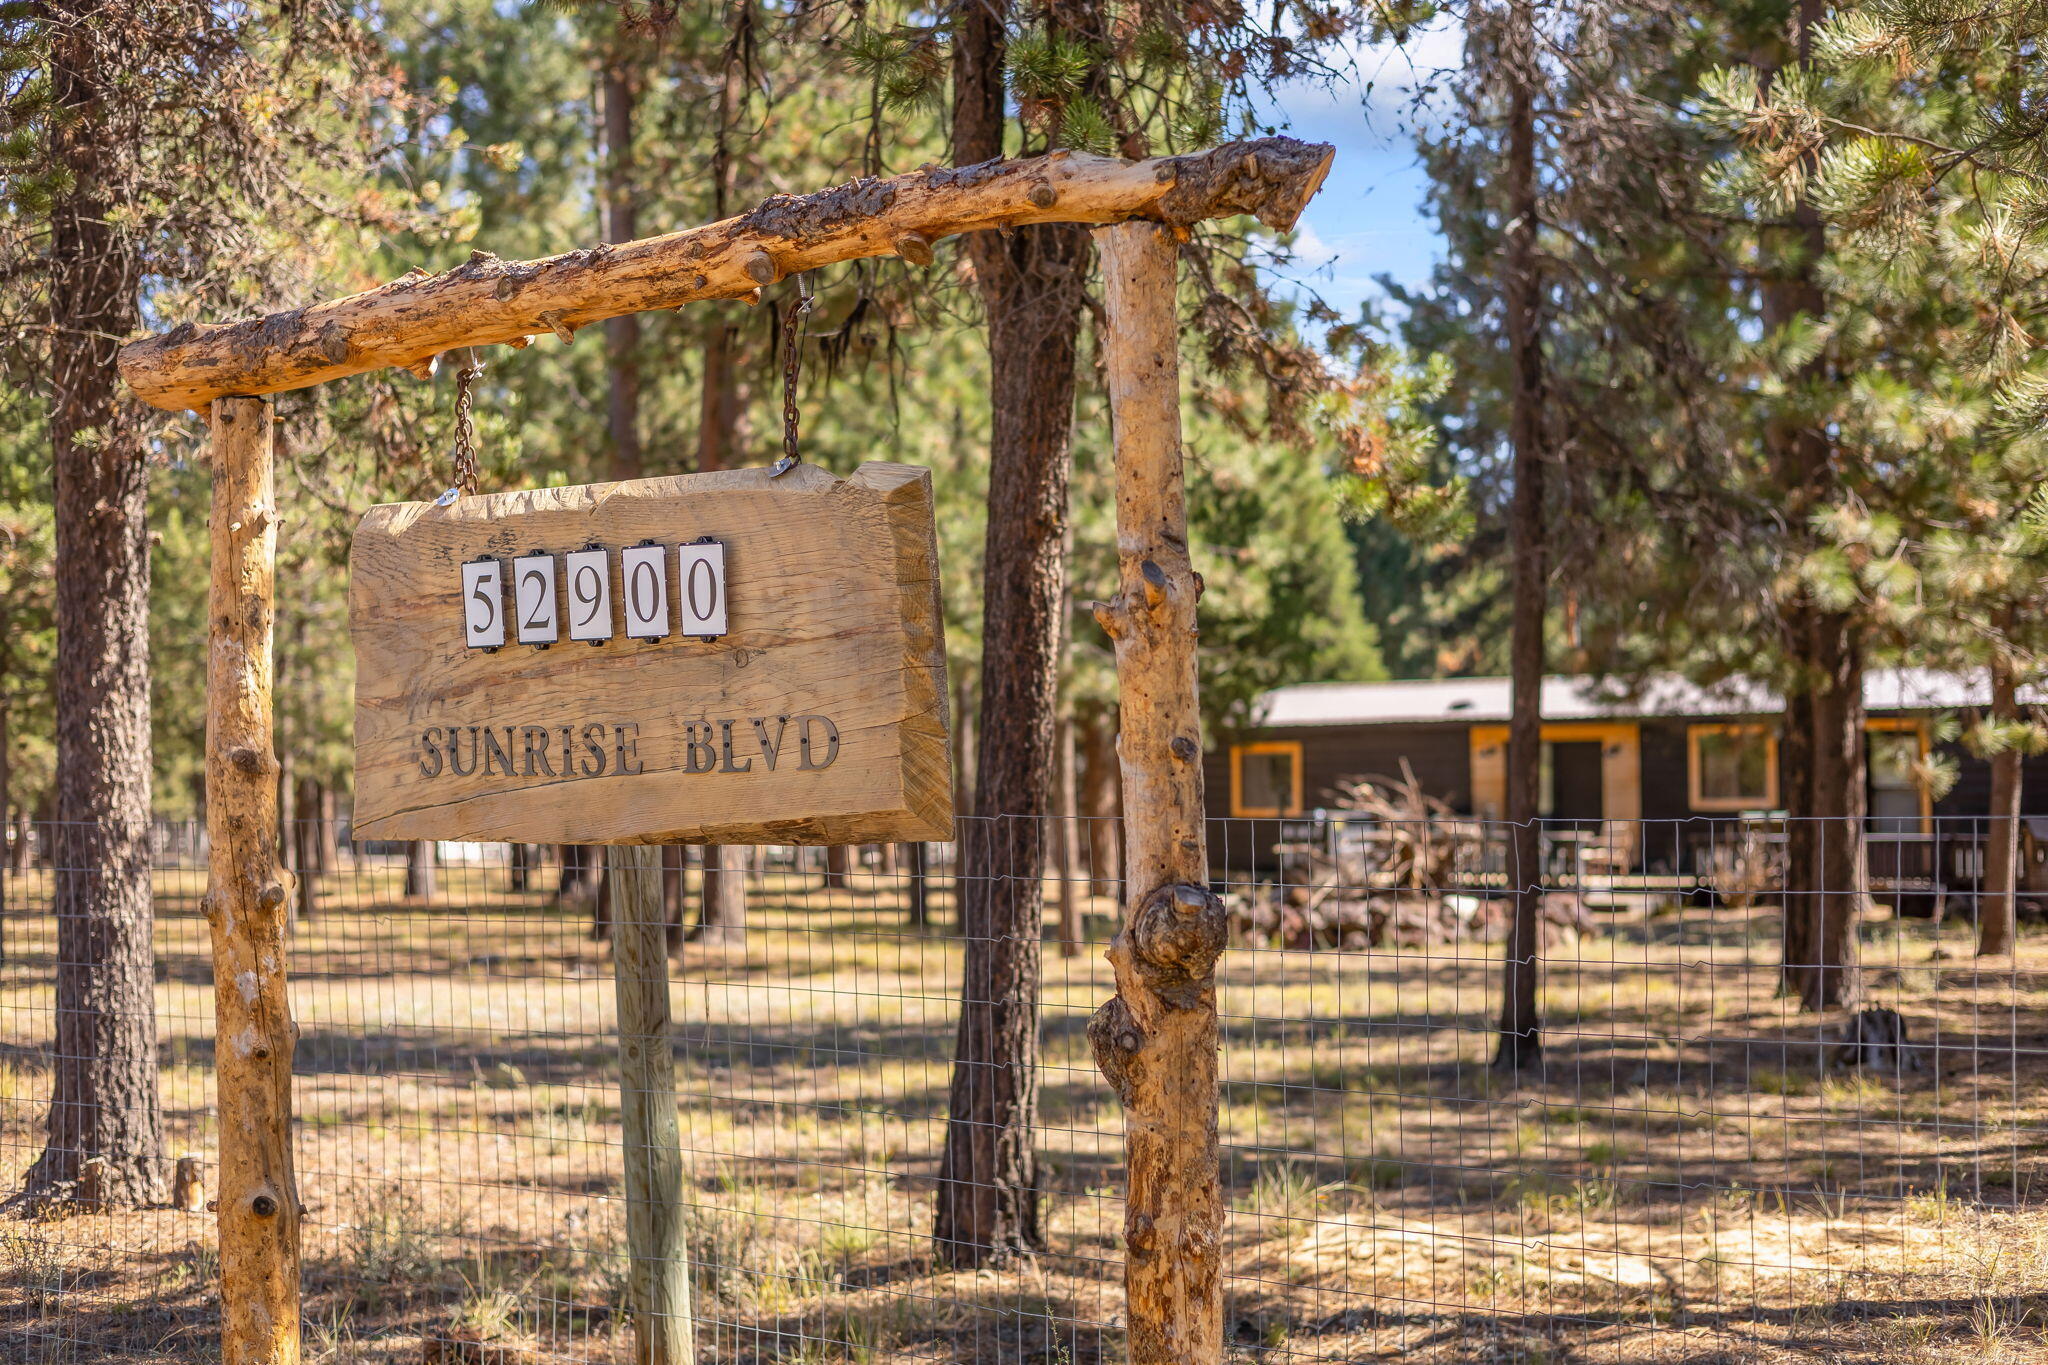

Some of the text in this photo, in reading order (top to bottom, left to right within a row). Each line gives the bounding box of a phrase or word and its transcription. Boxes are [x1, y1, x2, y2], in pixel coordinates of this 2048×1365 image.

[472, 558, 717, 633] 52900
[420, 714, 840, 778] SUNRISE BLVD
